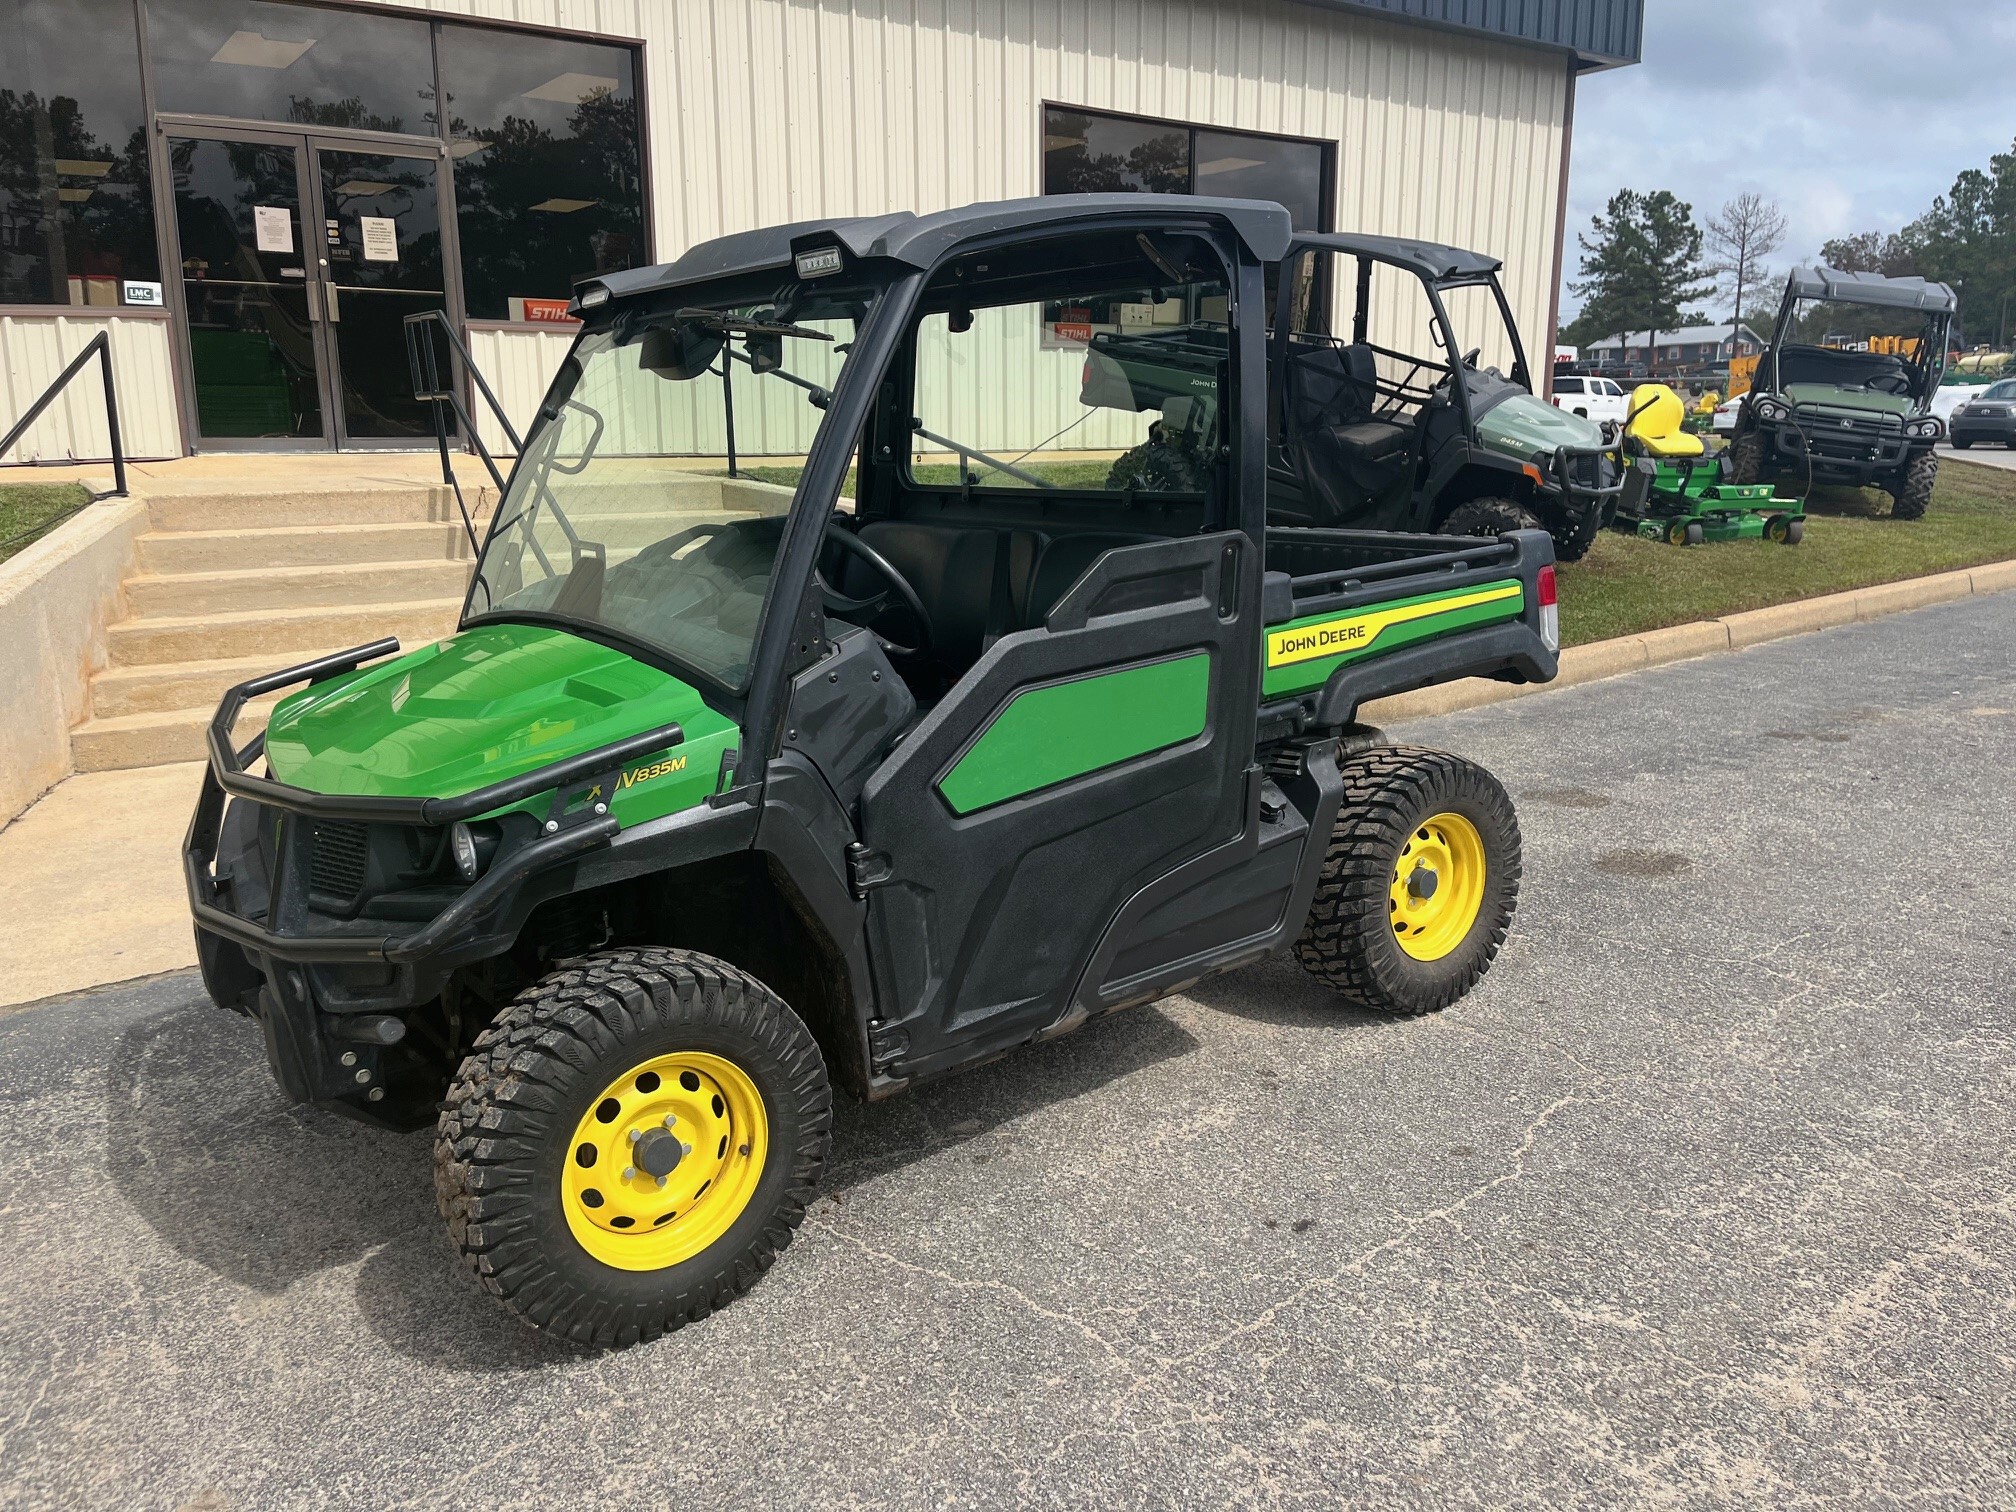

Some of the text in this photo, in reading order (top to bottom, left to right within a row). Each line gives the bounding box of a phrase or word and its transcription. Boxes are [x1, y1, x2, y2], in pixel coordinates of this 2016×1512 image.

[129, 288, 151, 298] LMC
[1061, 328, 1090, 340] STIHL
[1190, 379, 1210, 388] JOHN
[1278, 625, 1366, 655] JOHN DEERE
